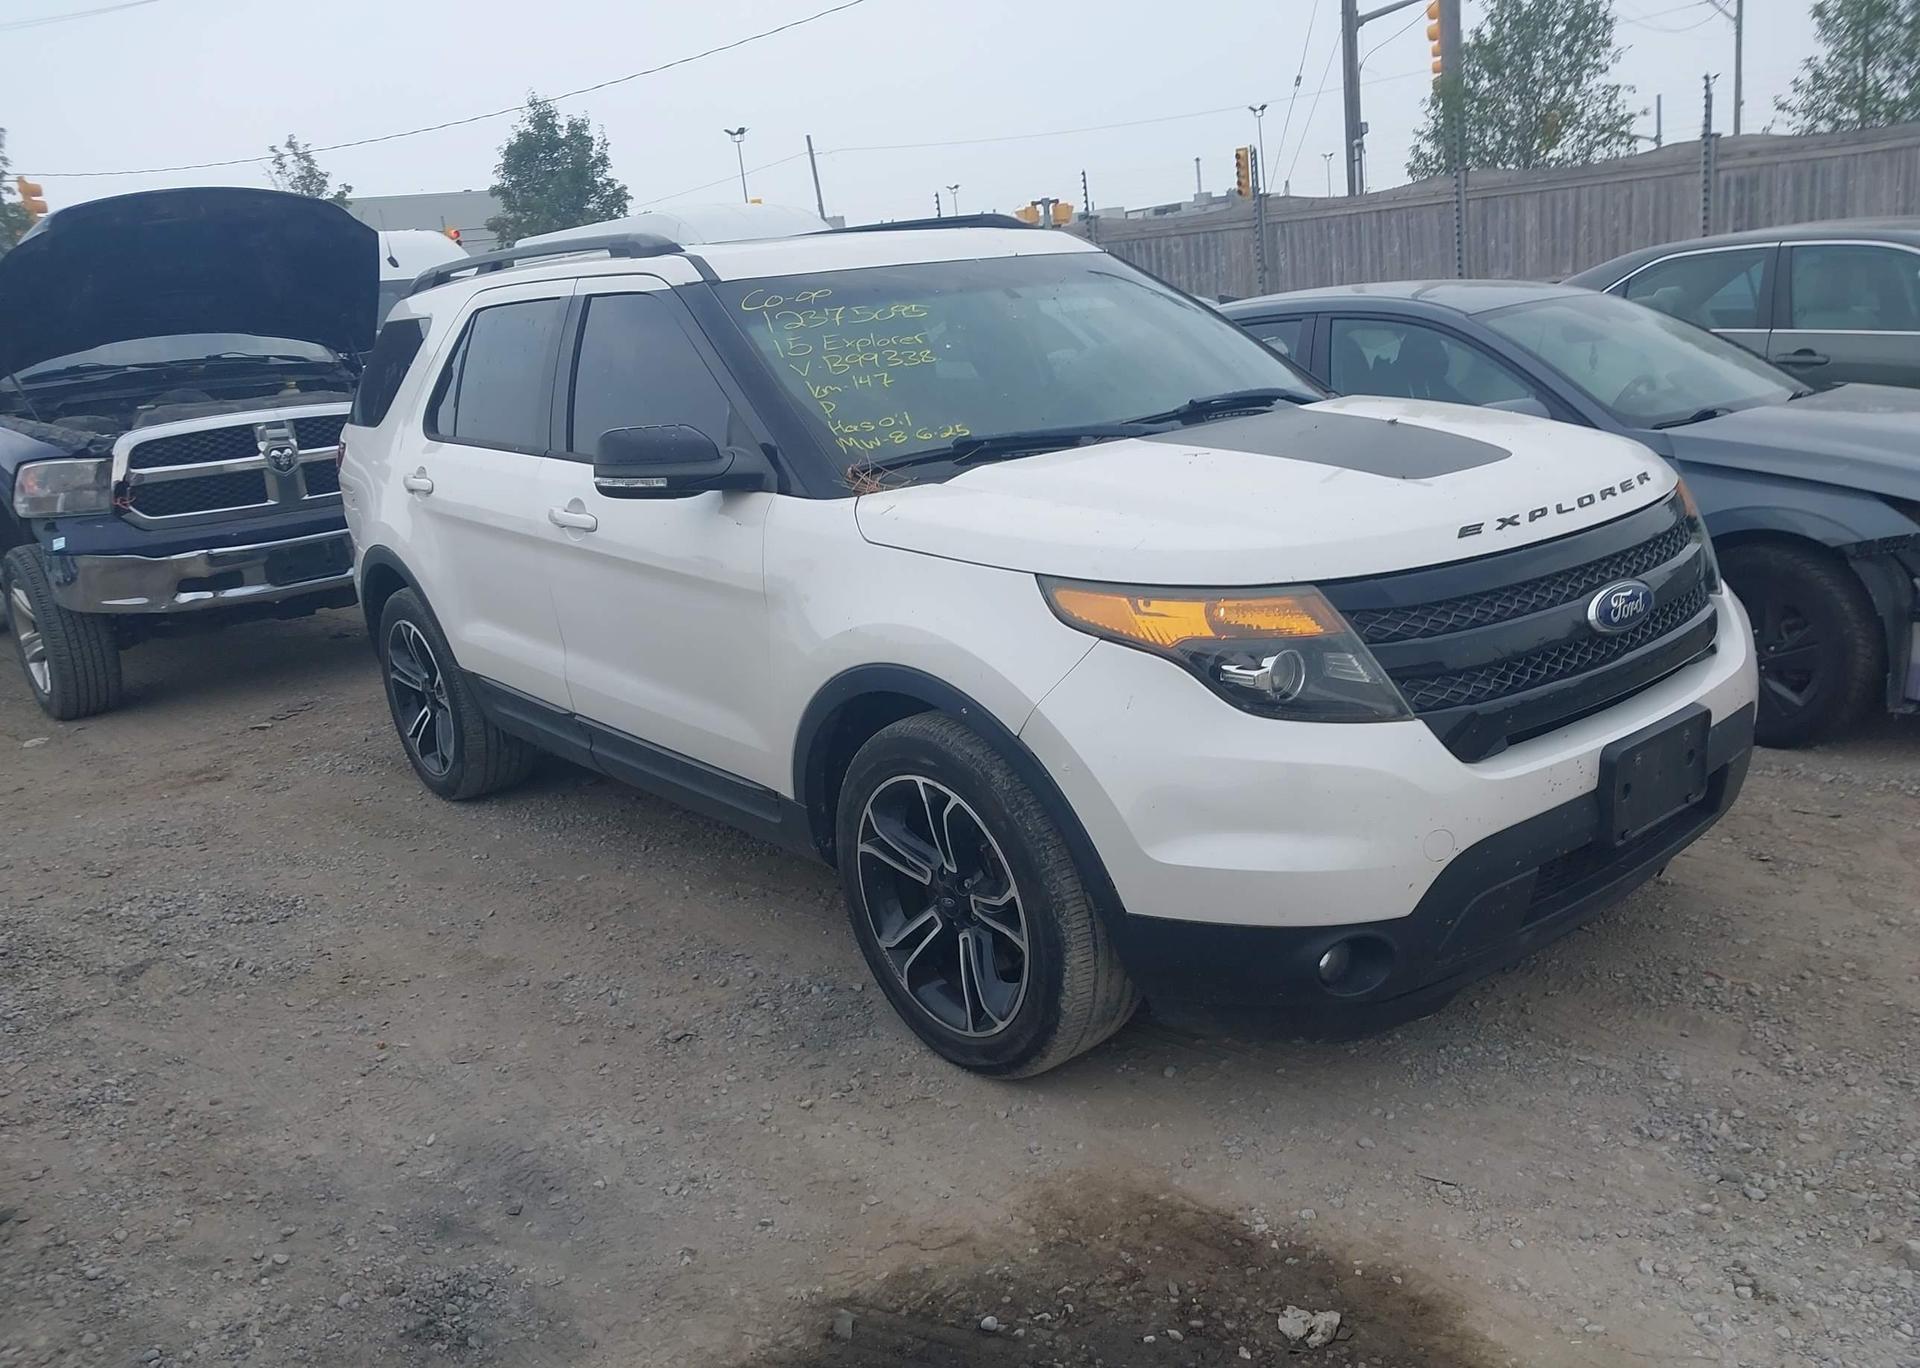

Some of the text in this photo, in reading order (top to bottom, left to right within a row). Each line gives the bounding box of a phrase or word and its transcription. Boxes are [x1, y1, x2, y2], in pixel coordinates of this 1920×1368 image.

[773, 331, 928, 358] 15 Explorer
[1457, 471, 1651, 539] EXPLORER
[1610, 589, 1646, 624] Ford
